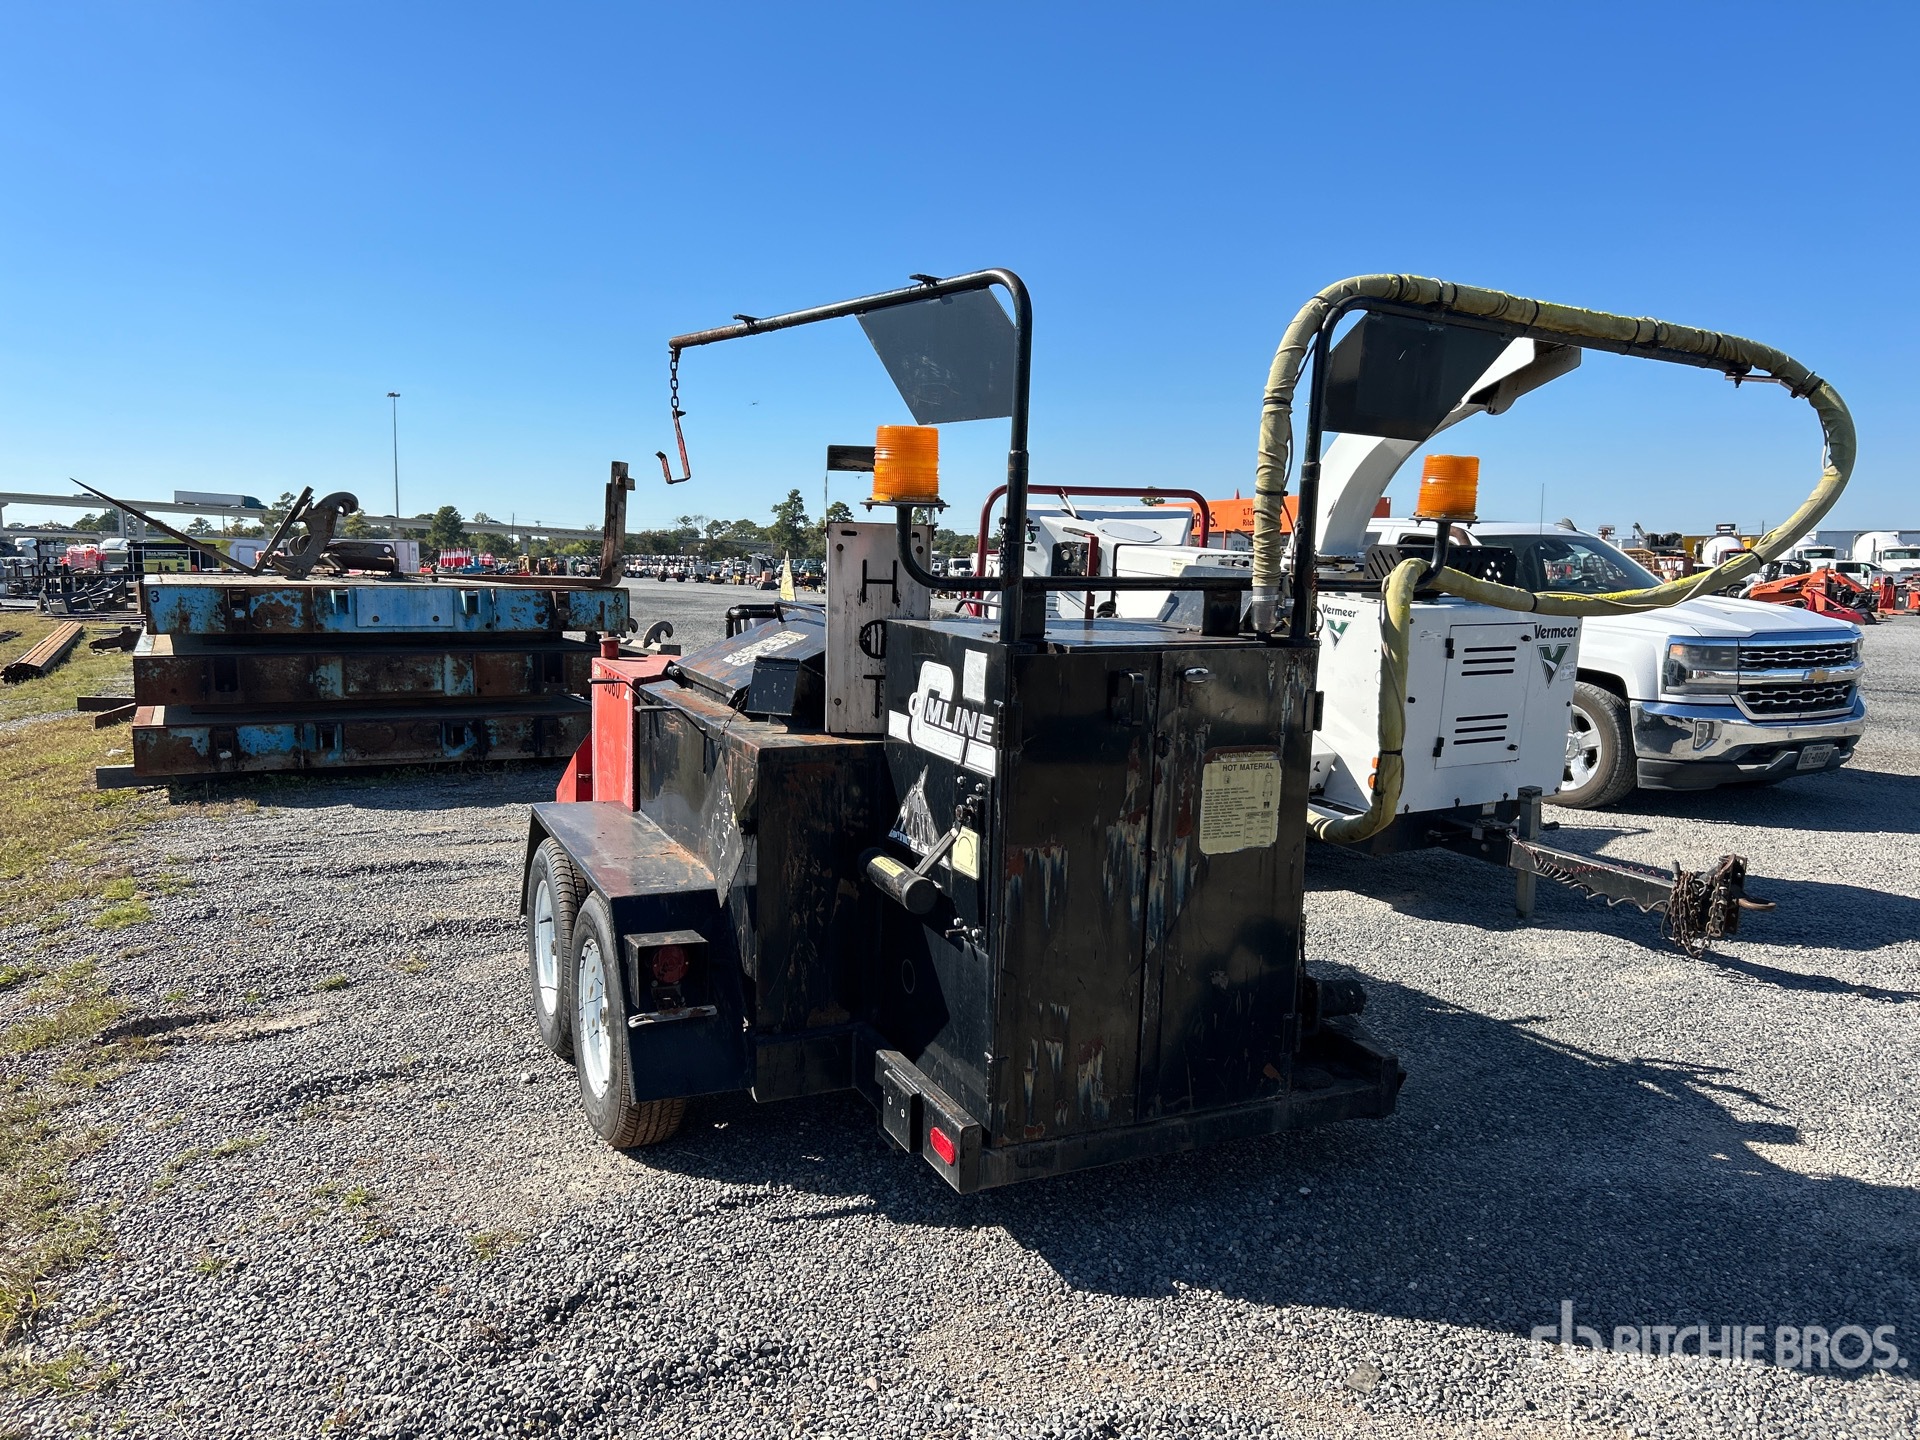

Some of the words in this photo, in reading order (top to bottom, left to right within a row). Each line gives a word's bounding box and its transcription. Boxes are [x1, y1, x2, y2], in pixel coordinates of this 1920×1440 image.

[150, 590, 160, 603] 3
[613, 593, 621, 604] 6
[1322, 603, 1357, 618] Vermeer
[1534, 624, 1579, 640] Vermeer
[1222, 764, 1237, 772] HOT
[1239, 762, 1274, 771] MATERIAL
